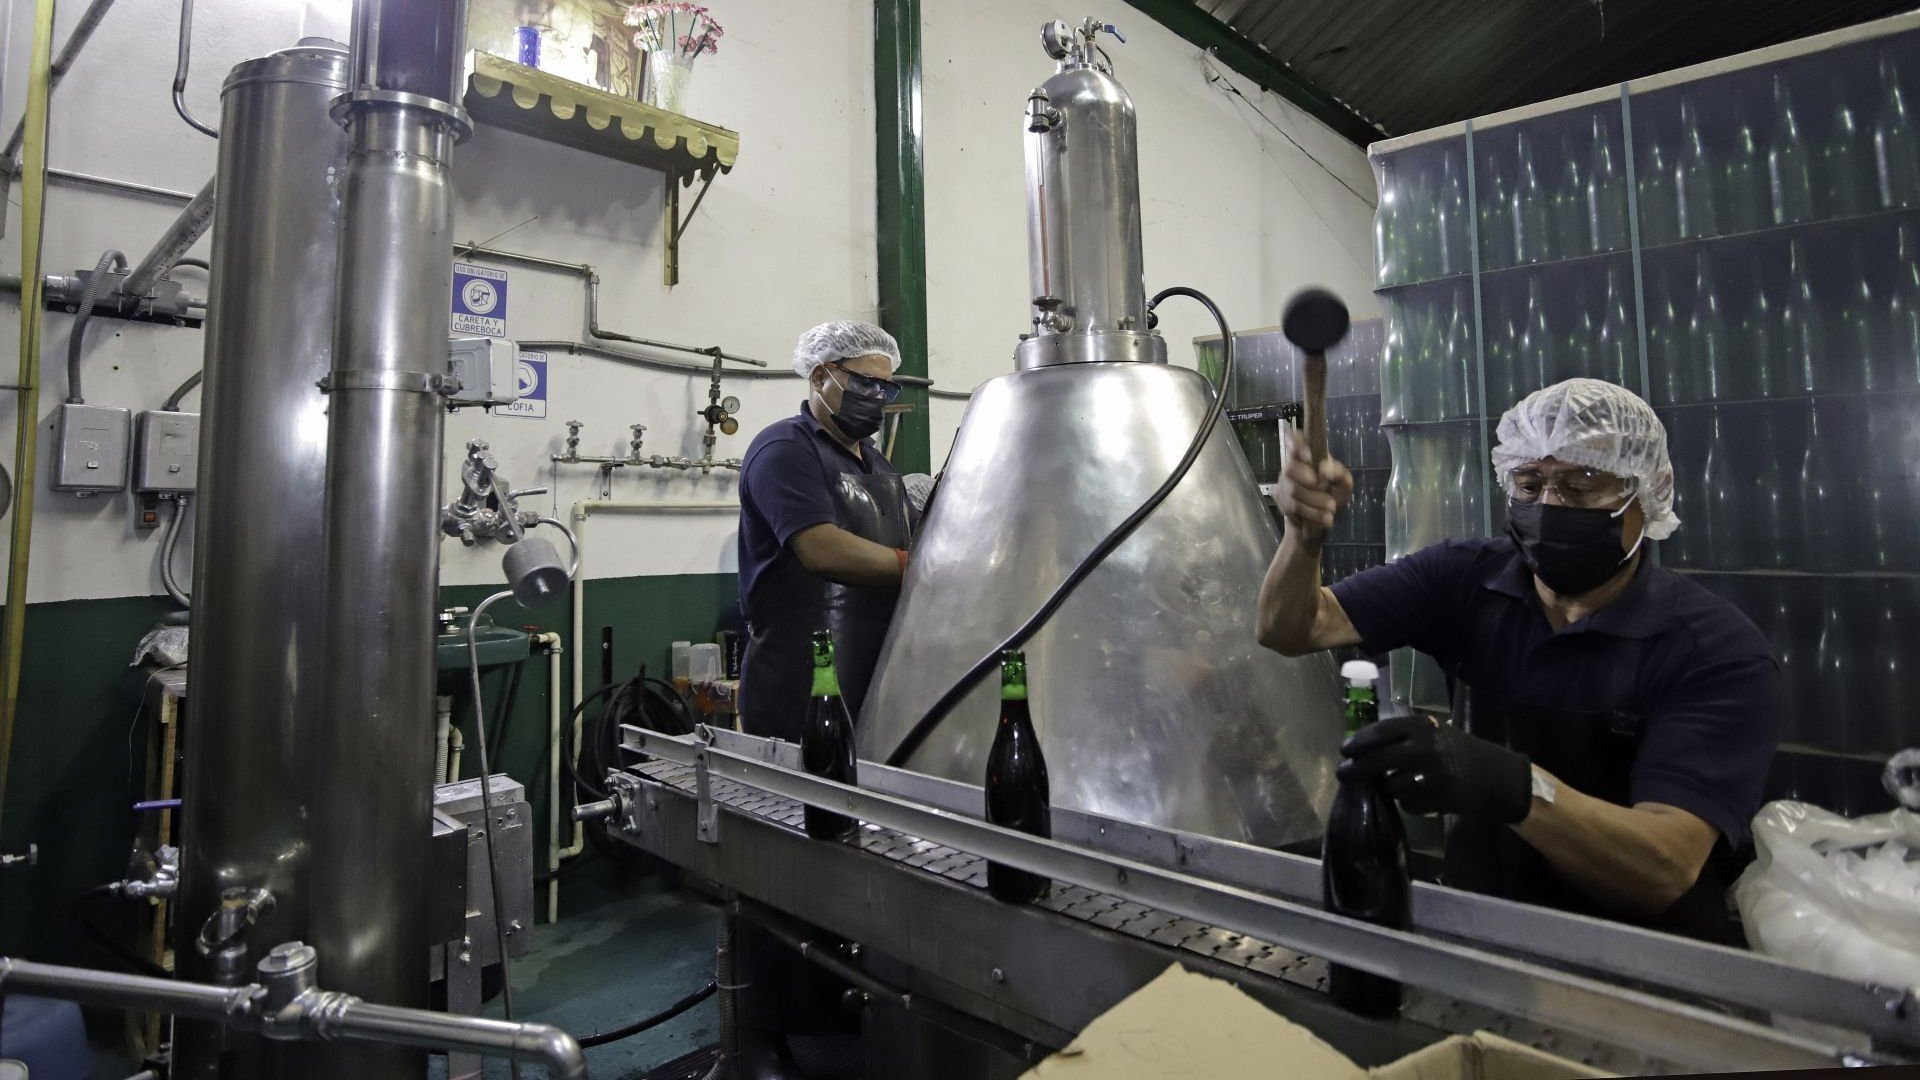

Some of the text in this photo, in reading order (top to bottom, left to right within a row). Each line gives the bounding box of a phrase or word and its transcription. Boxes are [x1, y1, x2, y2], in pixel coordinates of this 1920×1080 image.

[456, 265, 466, 273] USO
[458, 315, 499, 327] CARETA Y
[454, 322, 502, 335] CUBREBOCA
[1237, 412, 1263, 420] TRUPER
